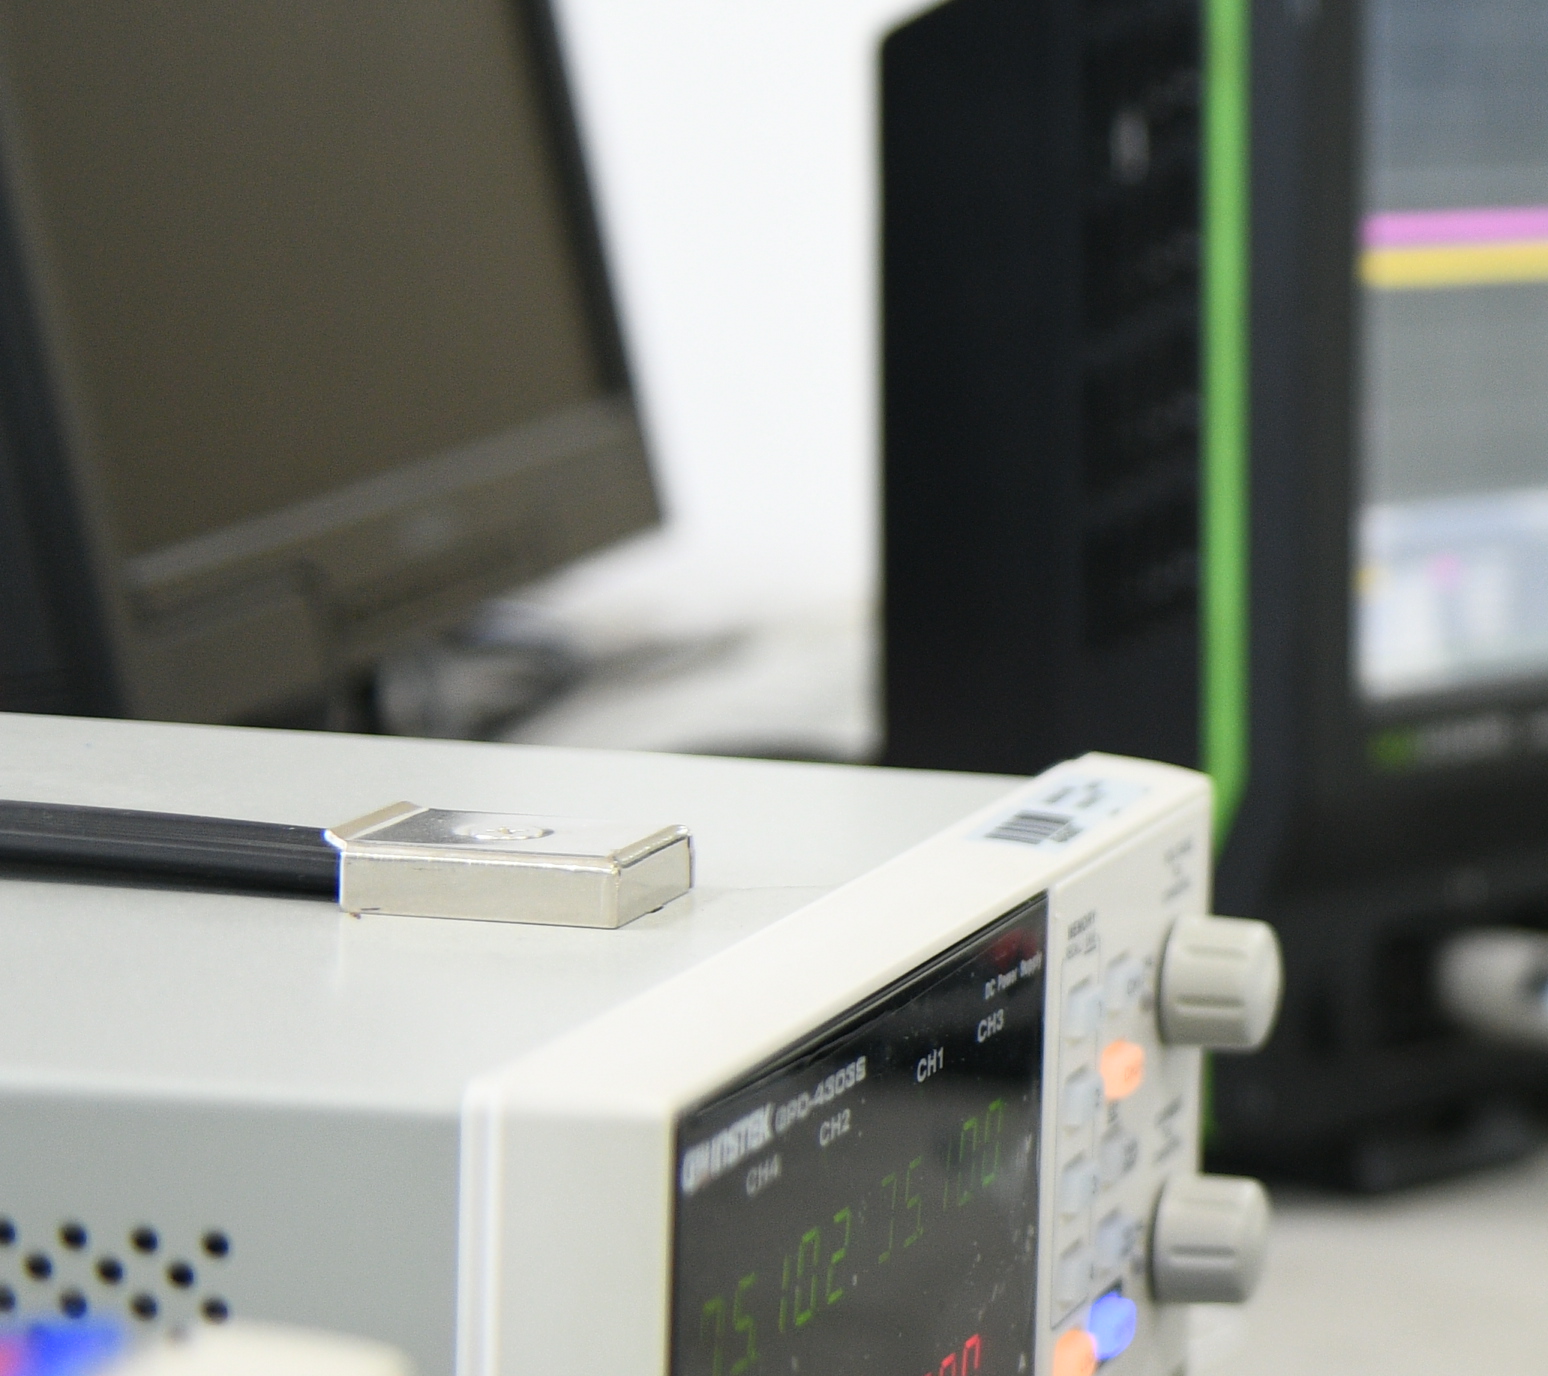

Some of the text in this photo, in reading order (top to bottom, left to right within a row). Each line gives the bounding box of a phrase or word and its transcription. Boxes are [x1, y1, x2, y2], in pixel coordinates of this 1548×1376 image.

[977, 1008, 1004, 1043] CH3
[916, 1046, 945, 1083] CH1
[819, 1108, 851, 1147] CH2
[745, 1152, 782, 1199] CH4
